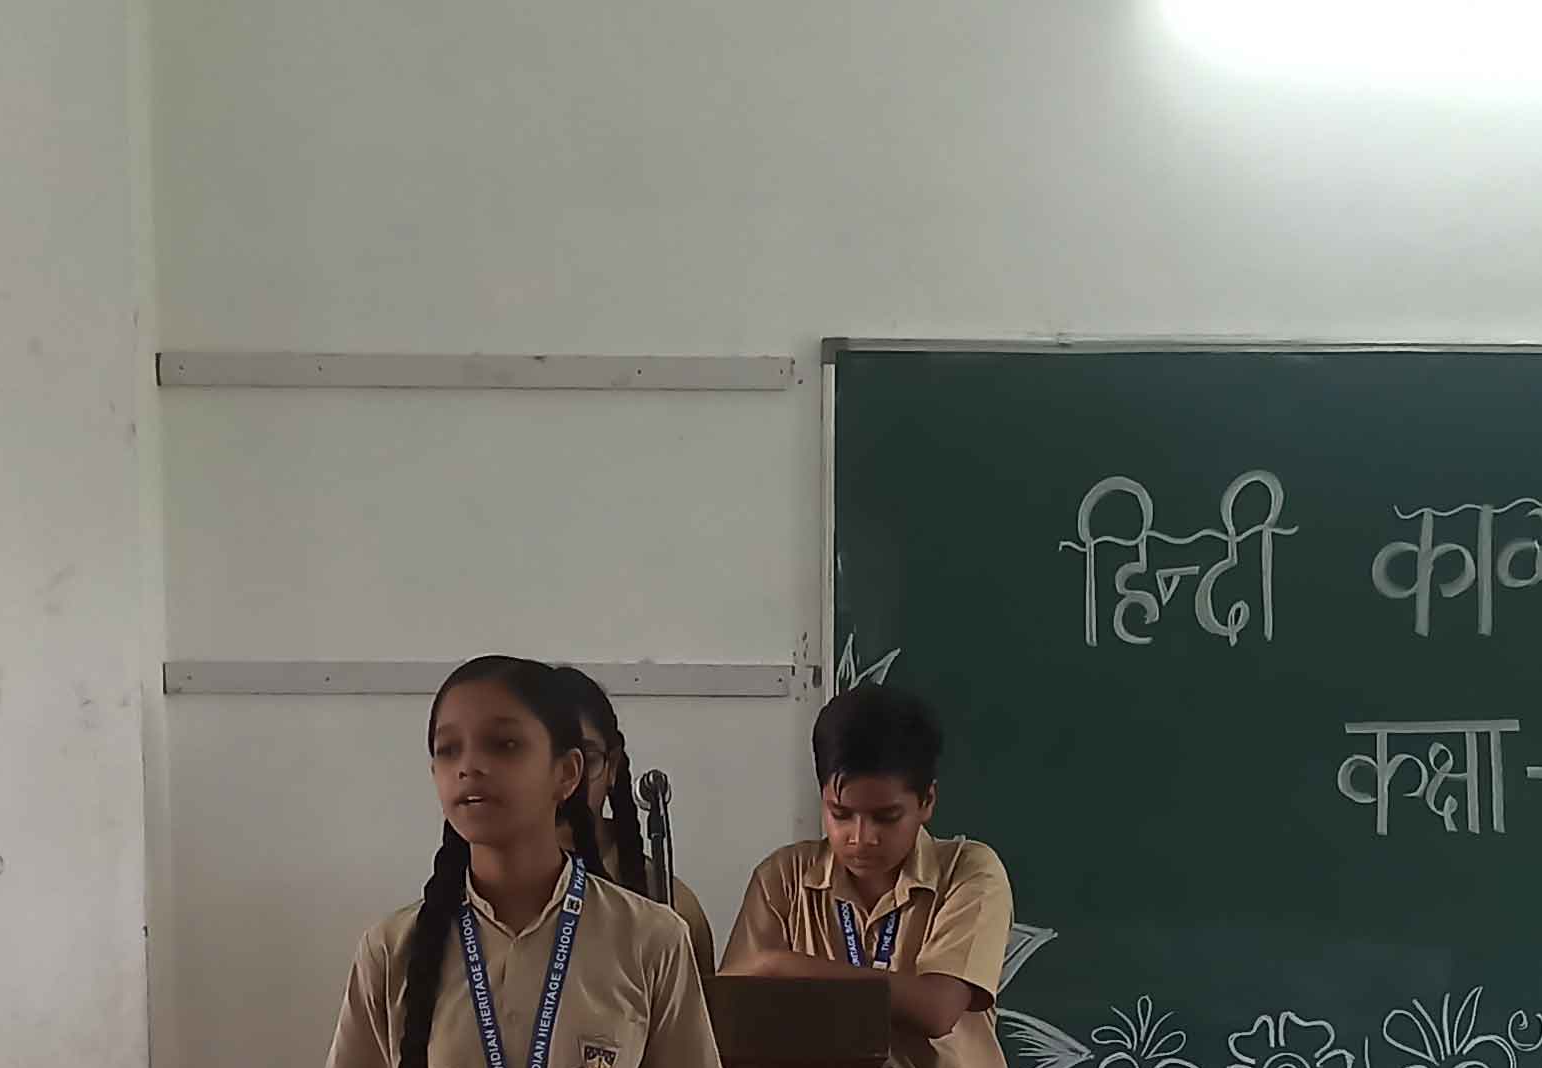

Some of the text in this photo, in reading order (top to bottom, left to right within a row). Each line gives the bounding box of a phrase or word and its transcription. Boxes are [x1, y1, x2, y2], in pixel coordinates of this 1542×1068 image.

[1059, 469, 1299, 647] हिन्दी
[461, 912, 480, 962] SCHOOL
[538, 971, 562, 1037] HERITAGE
[553, 919, 576, 970] SCHOOL
[471, 963, 496, 1029] HERITAGE
